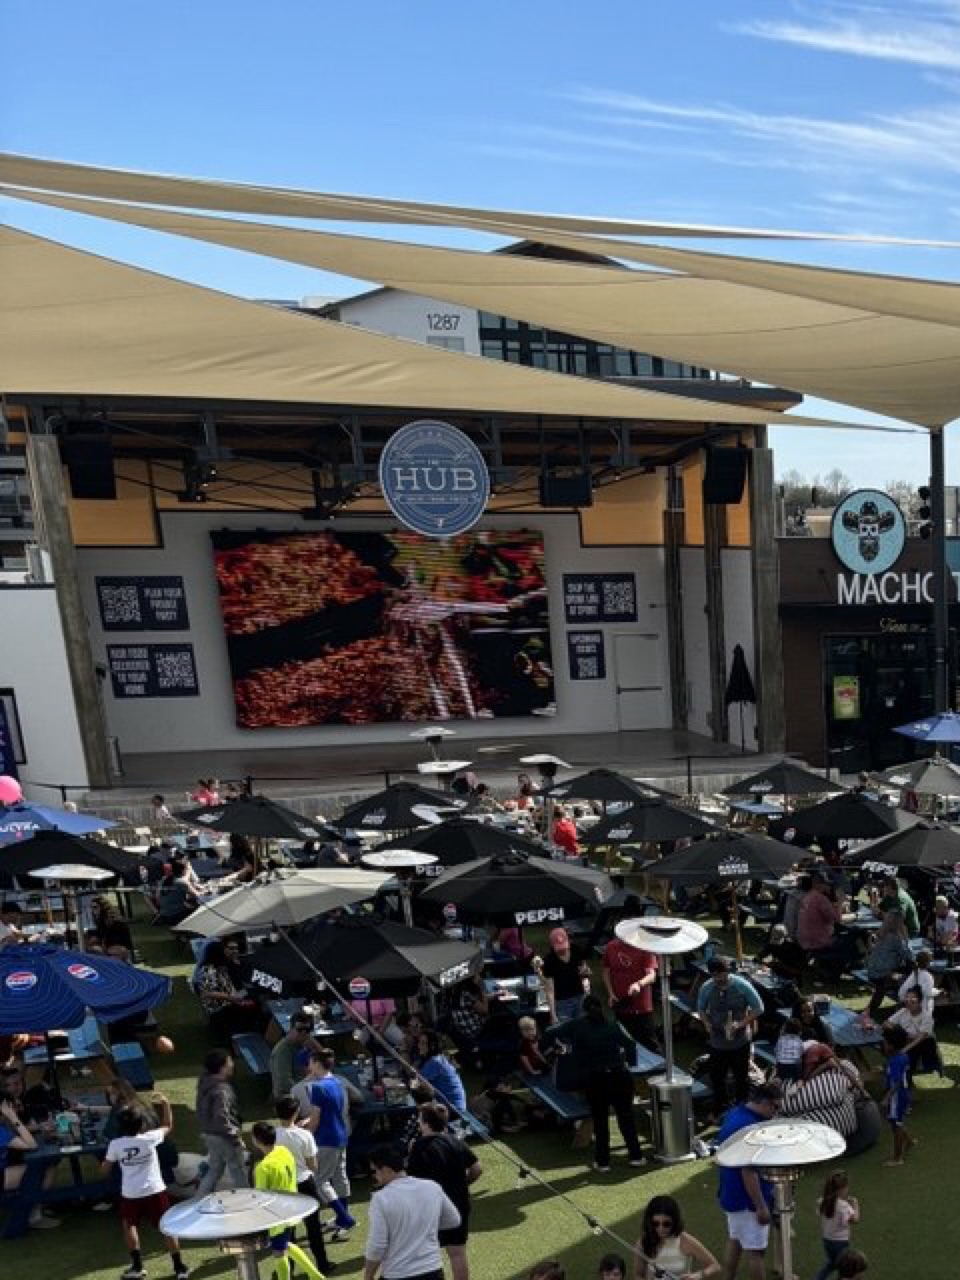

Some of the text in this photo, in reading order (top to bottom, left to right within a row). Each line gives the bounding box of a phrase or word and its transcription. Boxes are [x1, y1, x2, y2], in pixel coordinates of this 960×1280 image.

[427, 313, 461, 331] 1287
[391, 467, 478, 491] HUB
[415, 865, 445, 877] PEP
[861, 860, 899, 876] PEPSI
[514, 906, 565, 925] PEPSI
[251, 968, 283, 994] PEPSI
